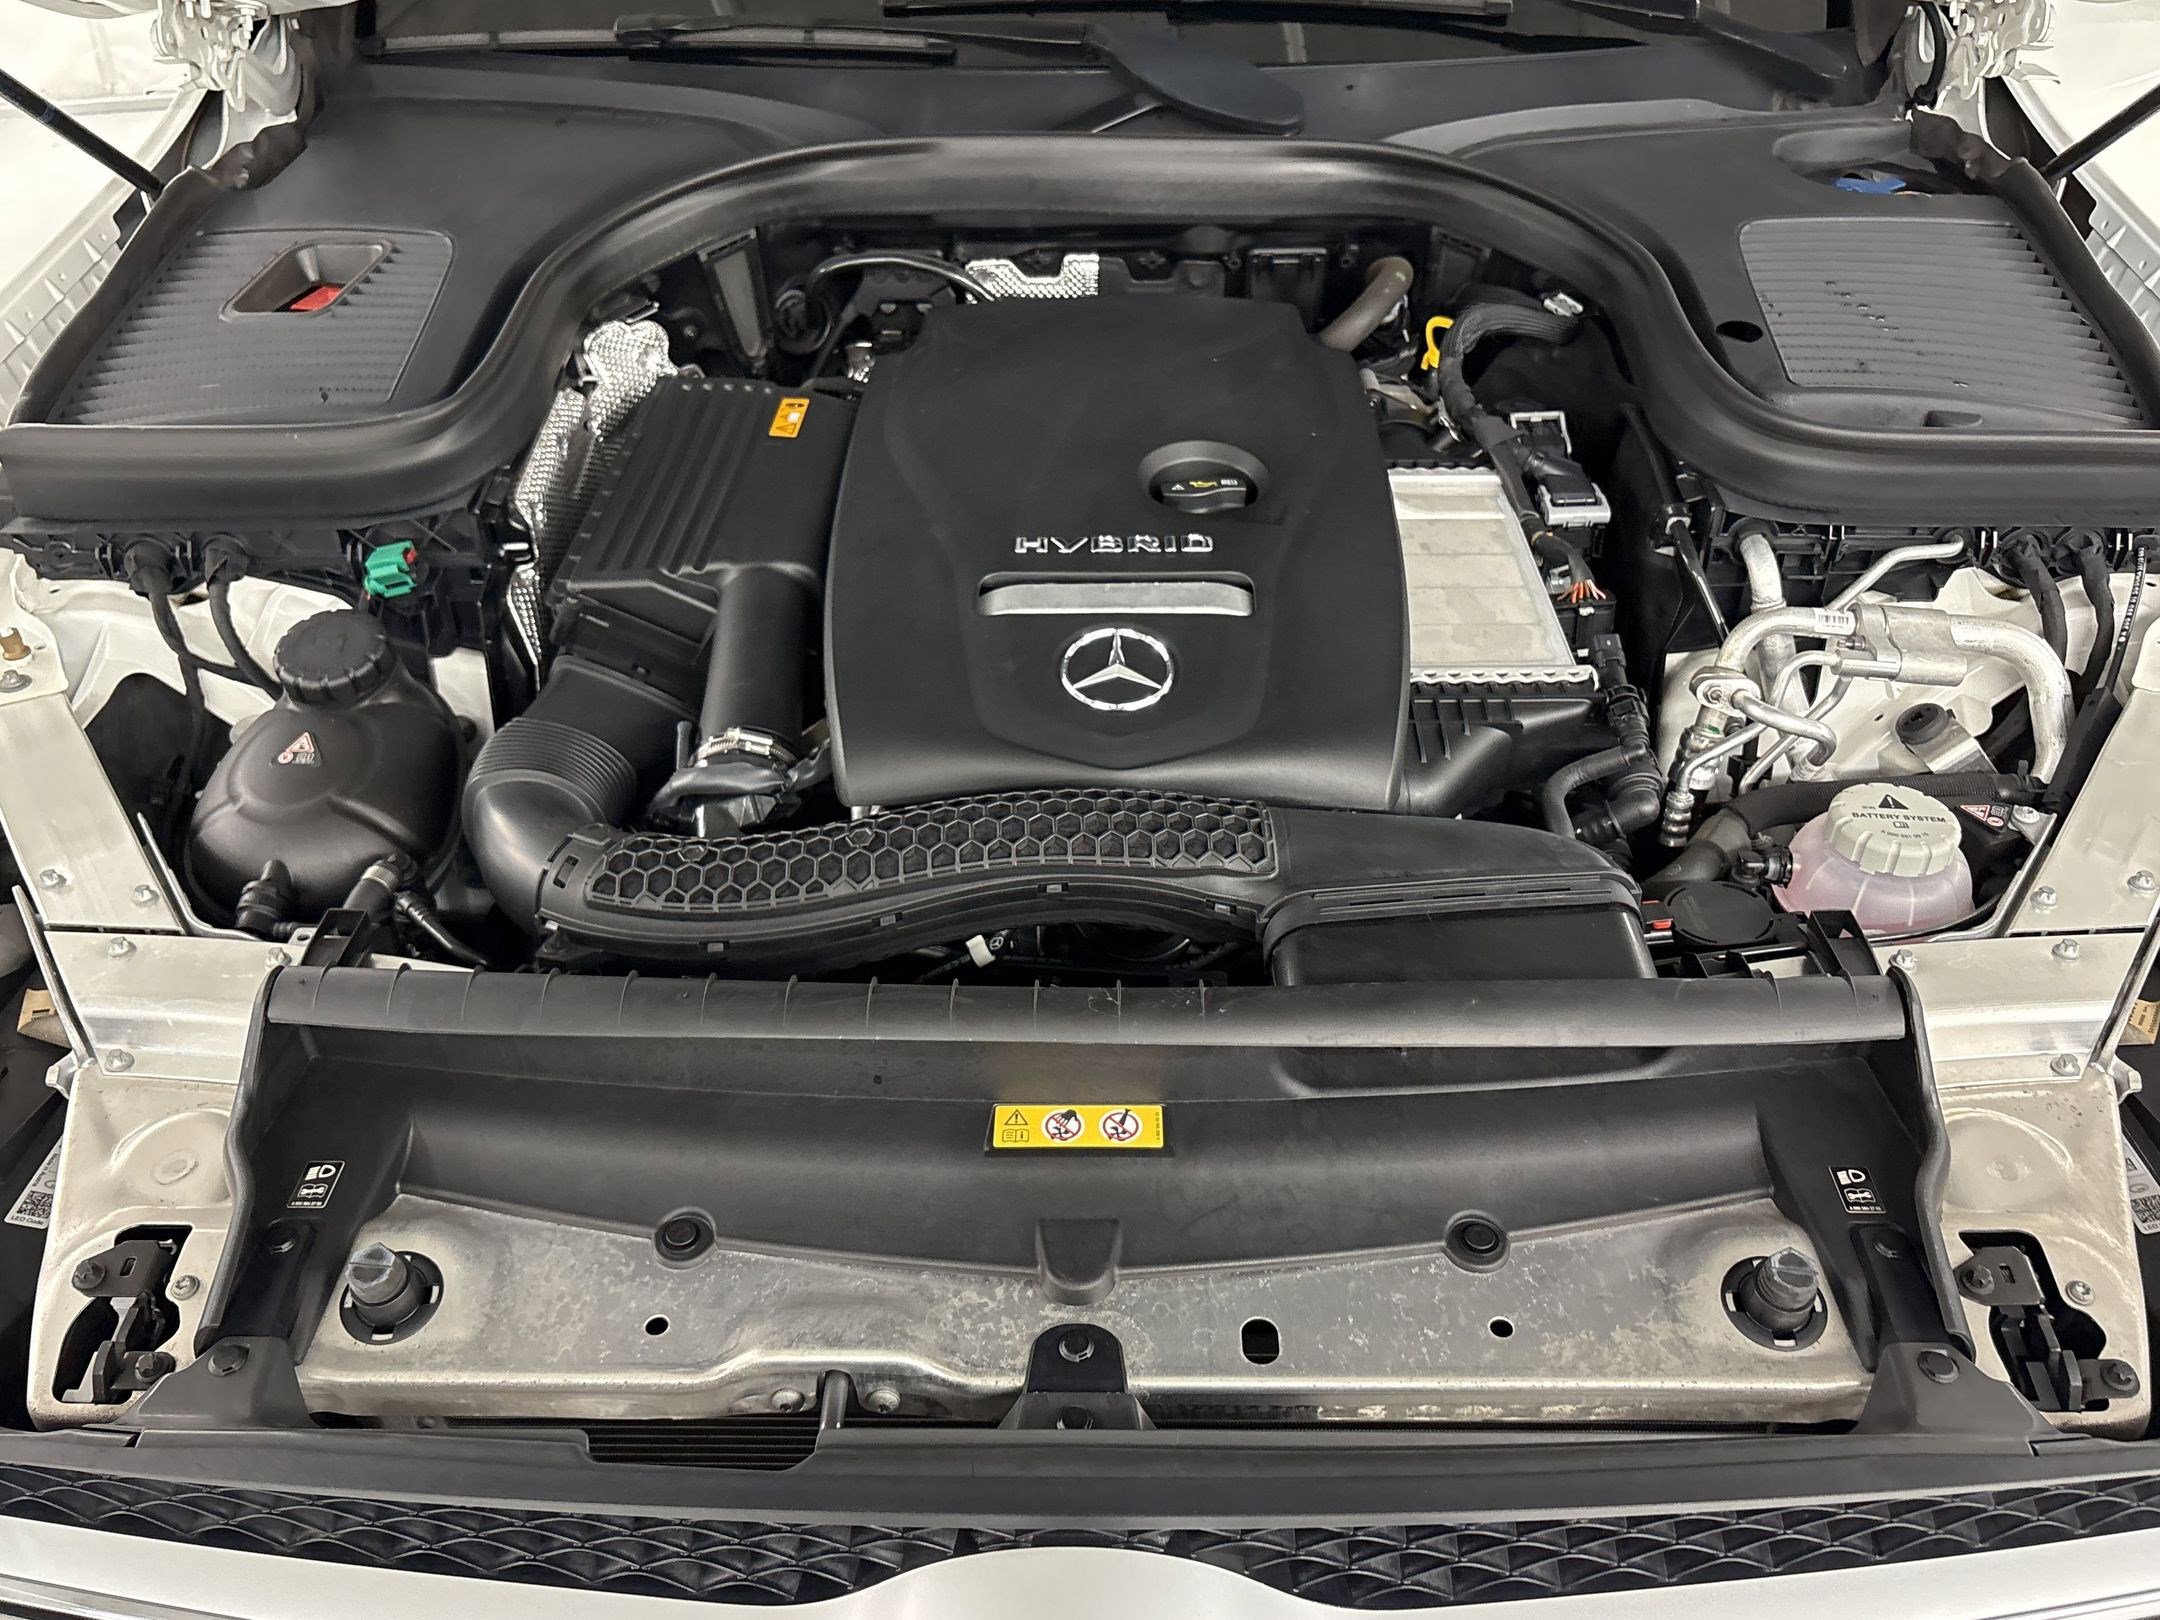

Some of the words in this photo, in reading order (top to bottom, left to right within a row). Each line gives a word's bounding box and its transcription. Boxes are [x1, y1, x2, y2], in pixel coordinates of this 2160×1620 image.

[1014, 534, 1214, 553] HYBRID
[1851, 812, 1900, 820] BATTERY
[1902, 815, 1947, 823] SYSTEM
